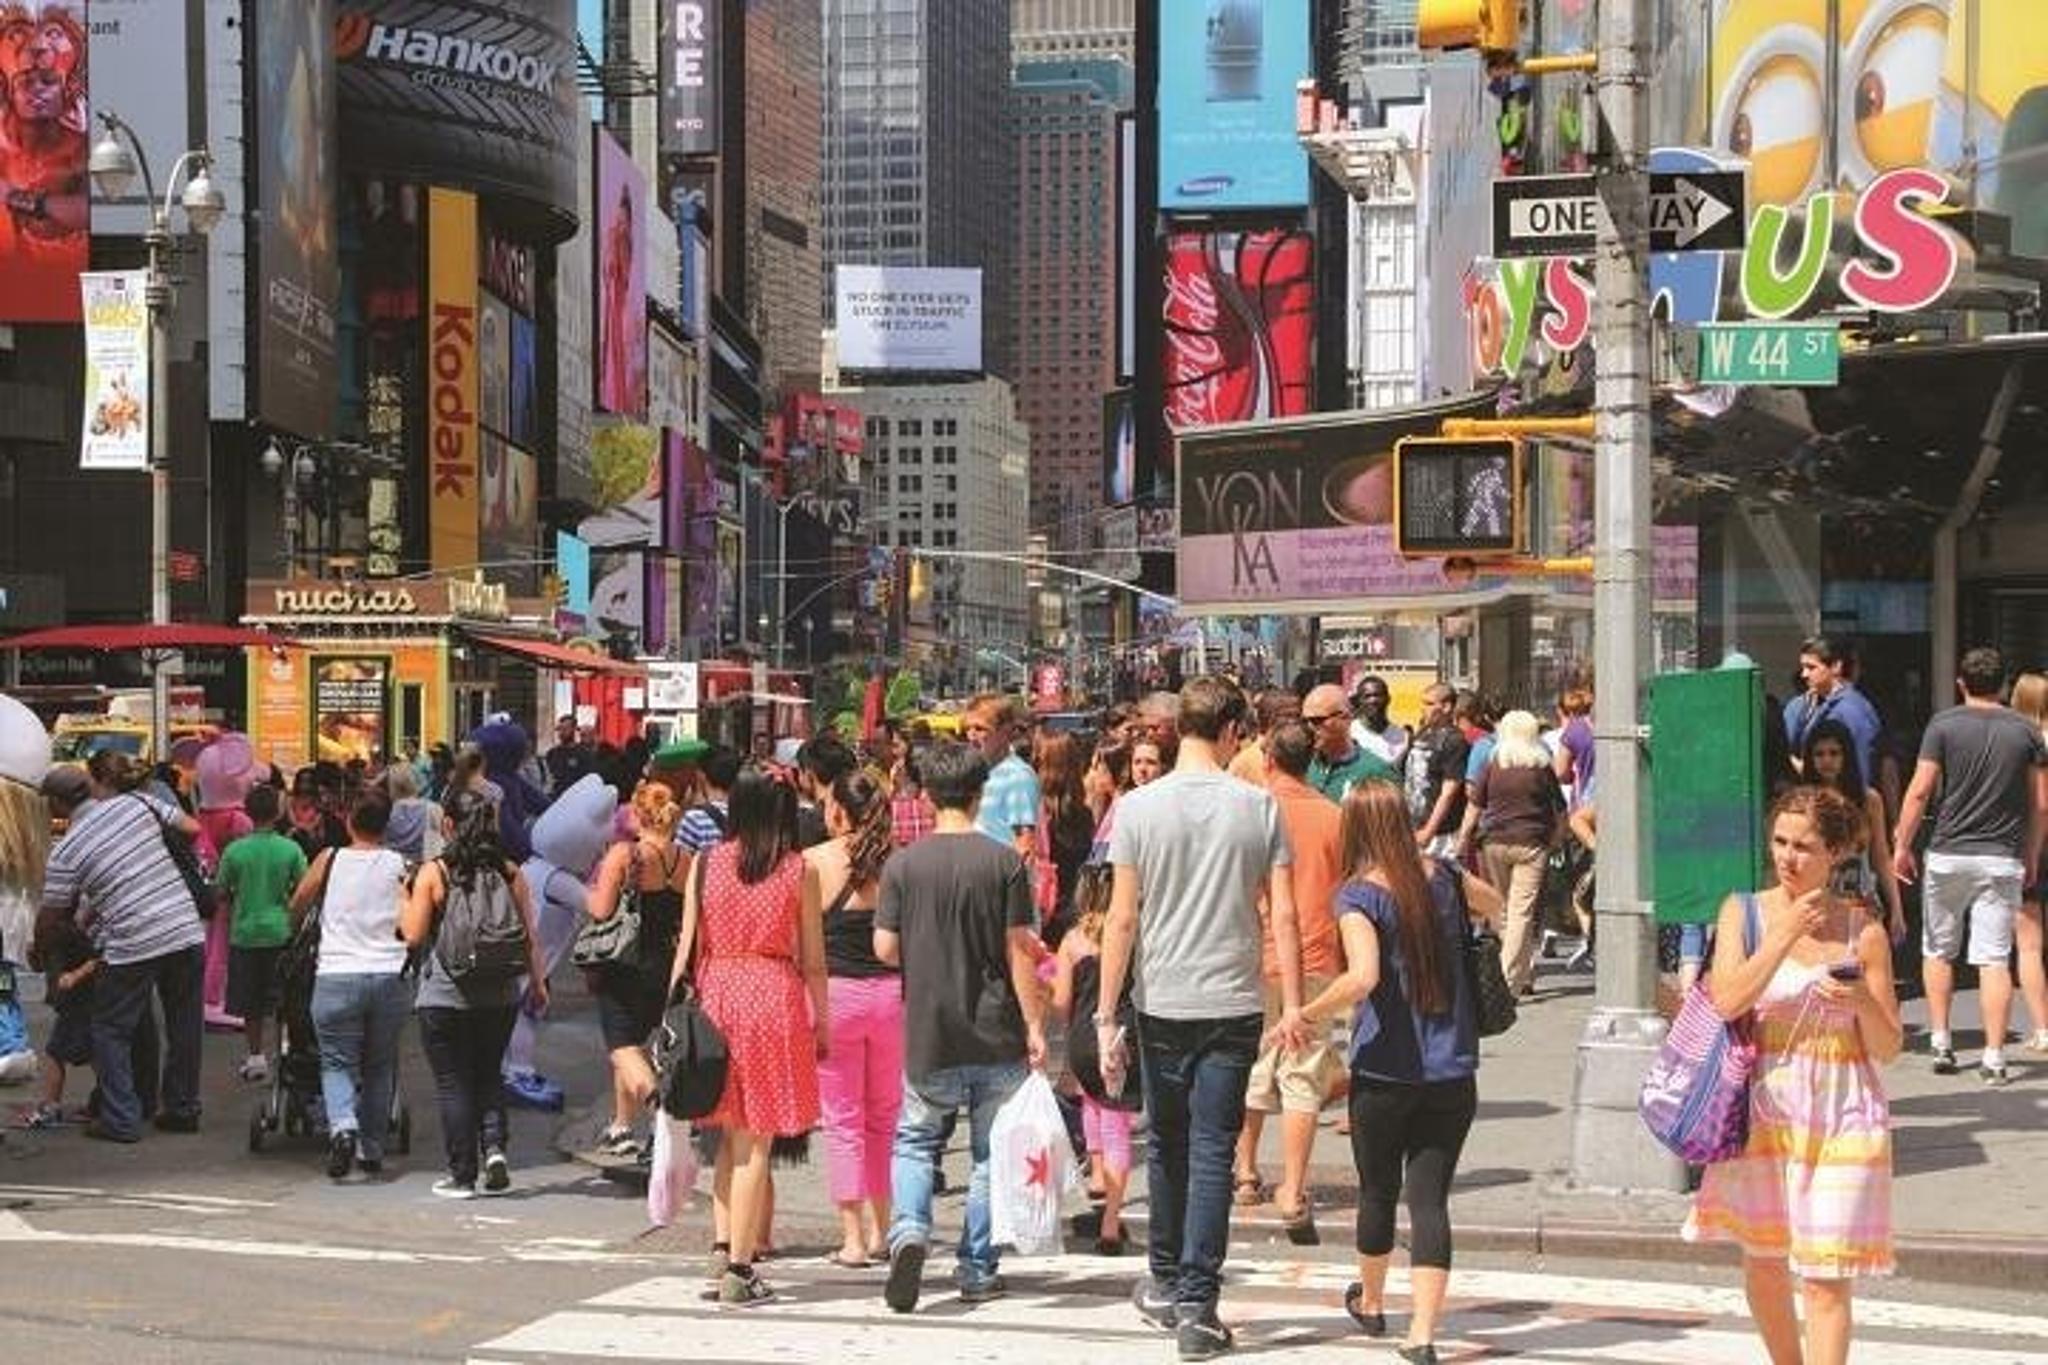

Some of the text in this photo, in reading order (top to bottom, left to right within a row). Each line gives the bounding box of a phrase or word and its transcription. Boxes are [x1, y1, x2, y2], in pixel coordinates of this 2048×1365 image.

[1530, 203, 1597, 233] ONE
[1711, 331, 1832, 377] W 44 ST
[434, 303, 474, 500] Kodak
[275, 585, 418, 614] nuchas
